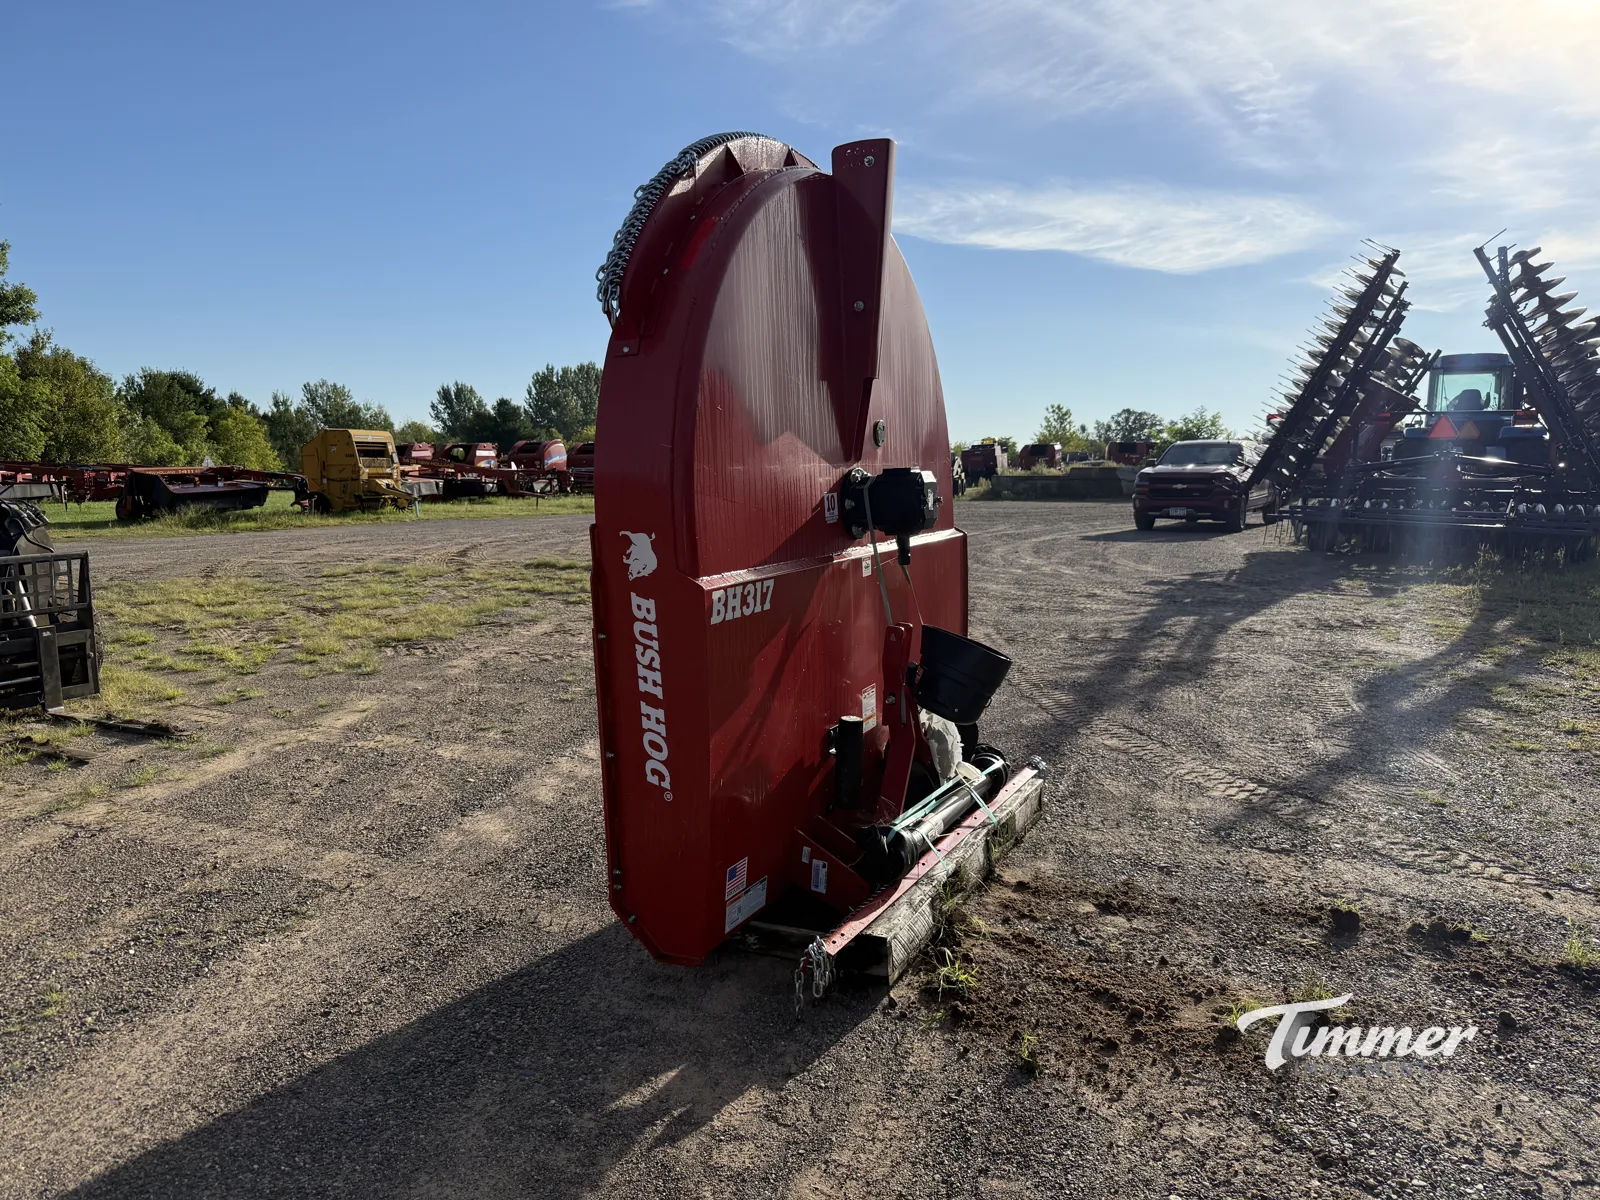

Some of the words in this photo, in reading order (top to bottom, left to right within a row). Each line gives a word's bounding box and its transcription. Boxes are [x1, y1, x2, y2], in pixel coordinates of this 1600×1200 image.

[826, 494, 836, 512] 10
[710, 579, 775, 626] BH317
[630, 592, 664, 700] BUSH
[640, 701, 672, 791] HOG
